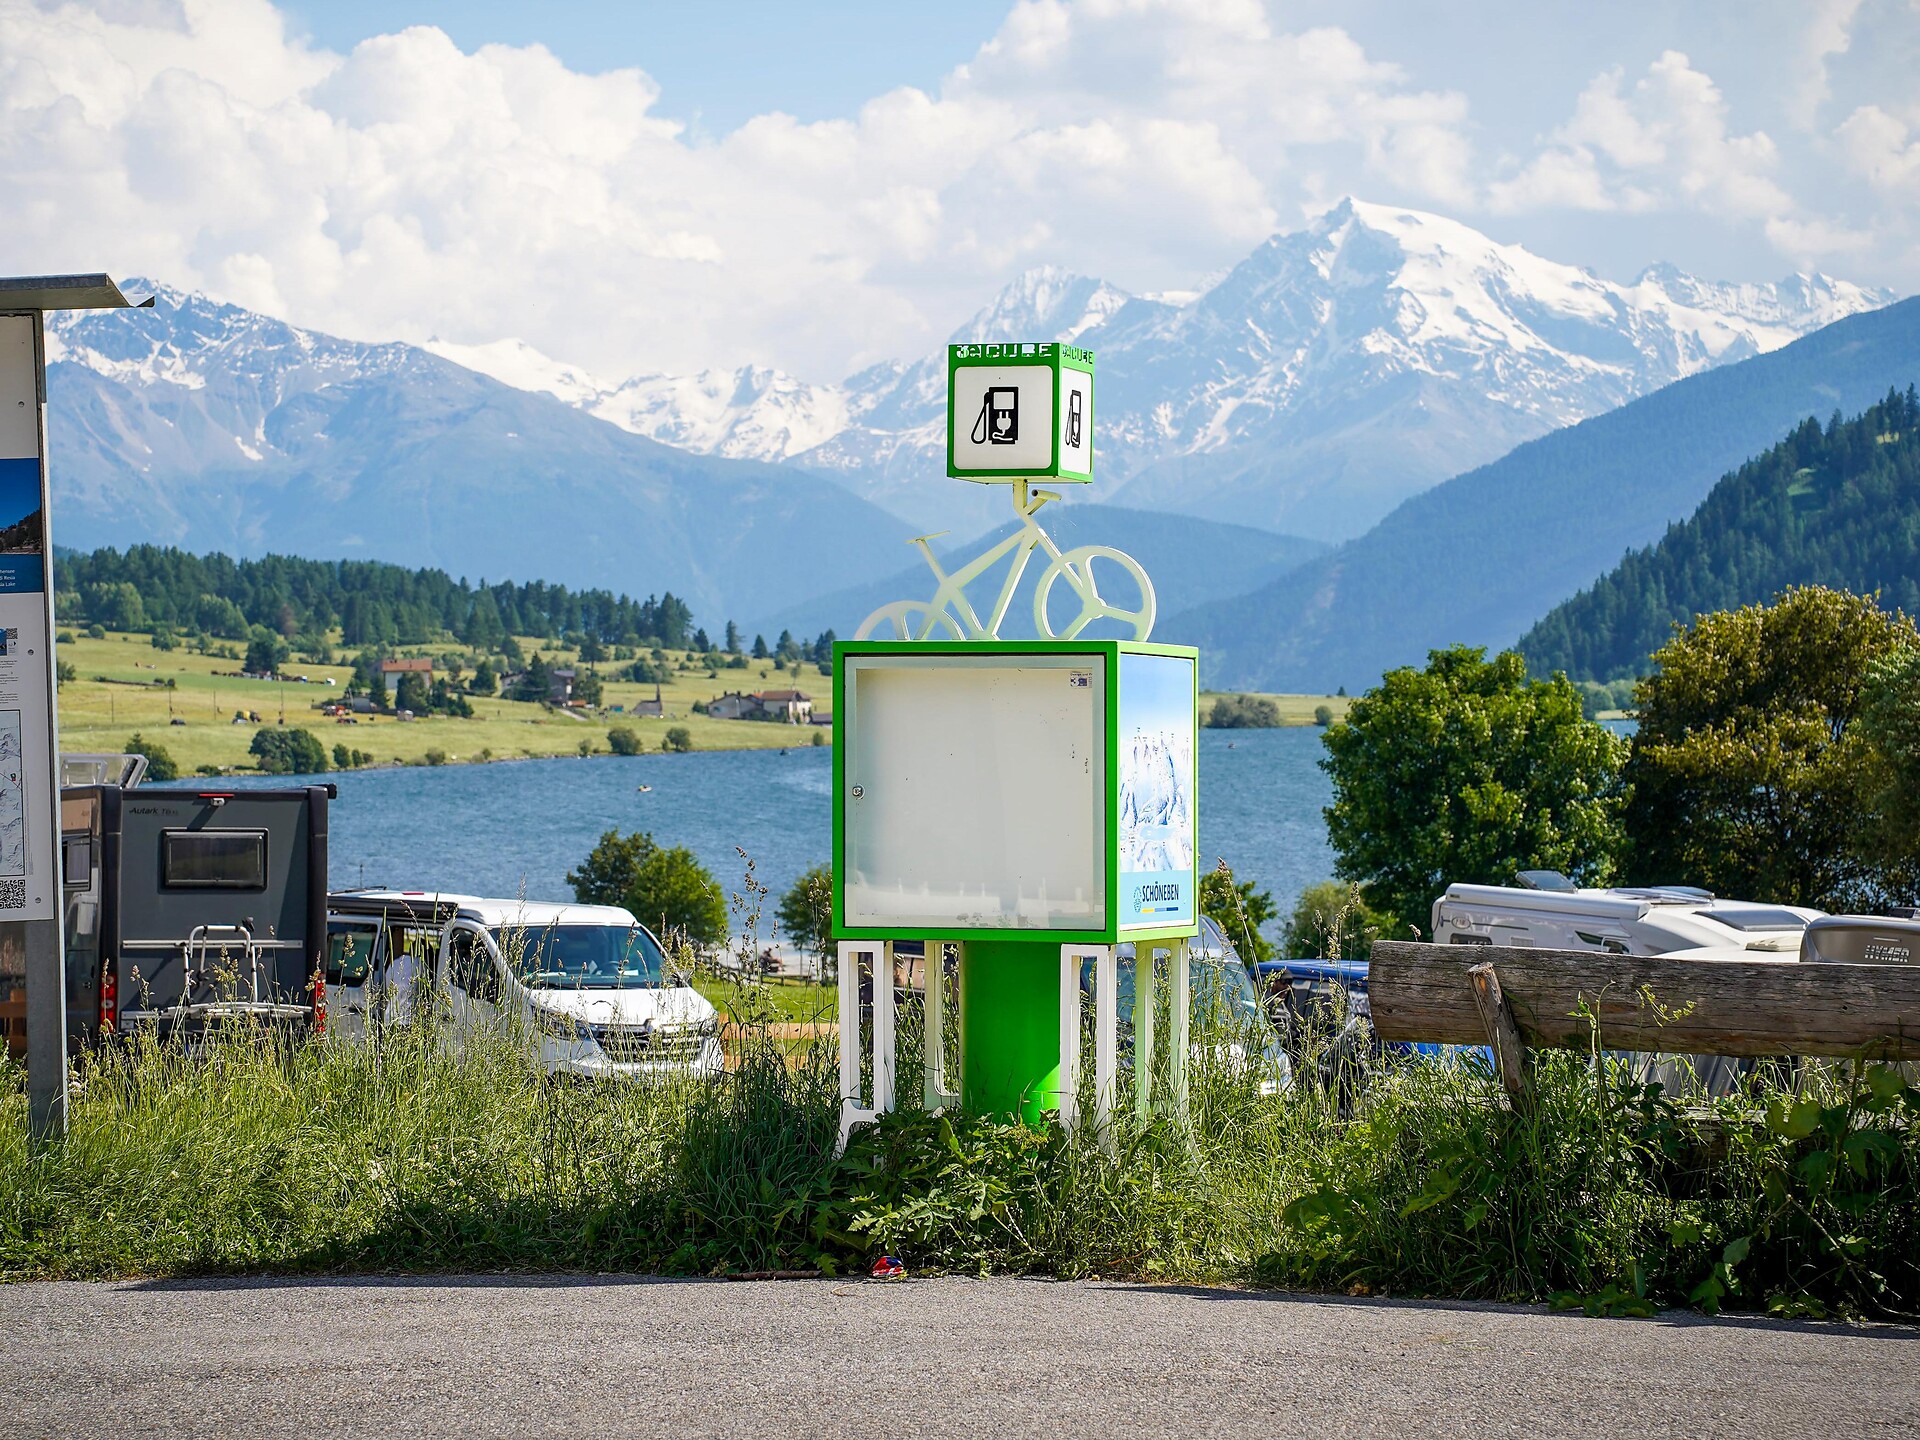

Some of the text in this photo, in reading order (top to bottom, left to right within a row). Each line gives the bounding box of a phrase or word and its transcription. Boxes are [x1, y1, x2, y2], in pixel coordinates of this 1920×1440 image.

[129, 807, 158, 815] Autark
[1142, 881, 1179, 902] SCHÖNEBEN
[1864, 945, 1910, 962] HYMER
